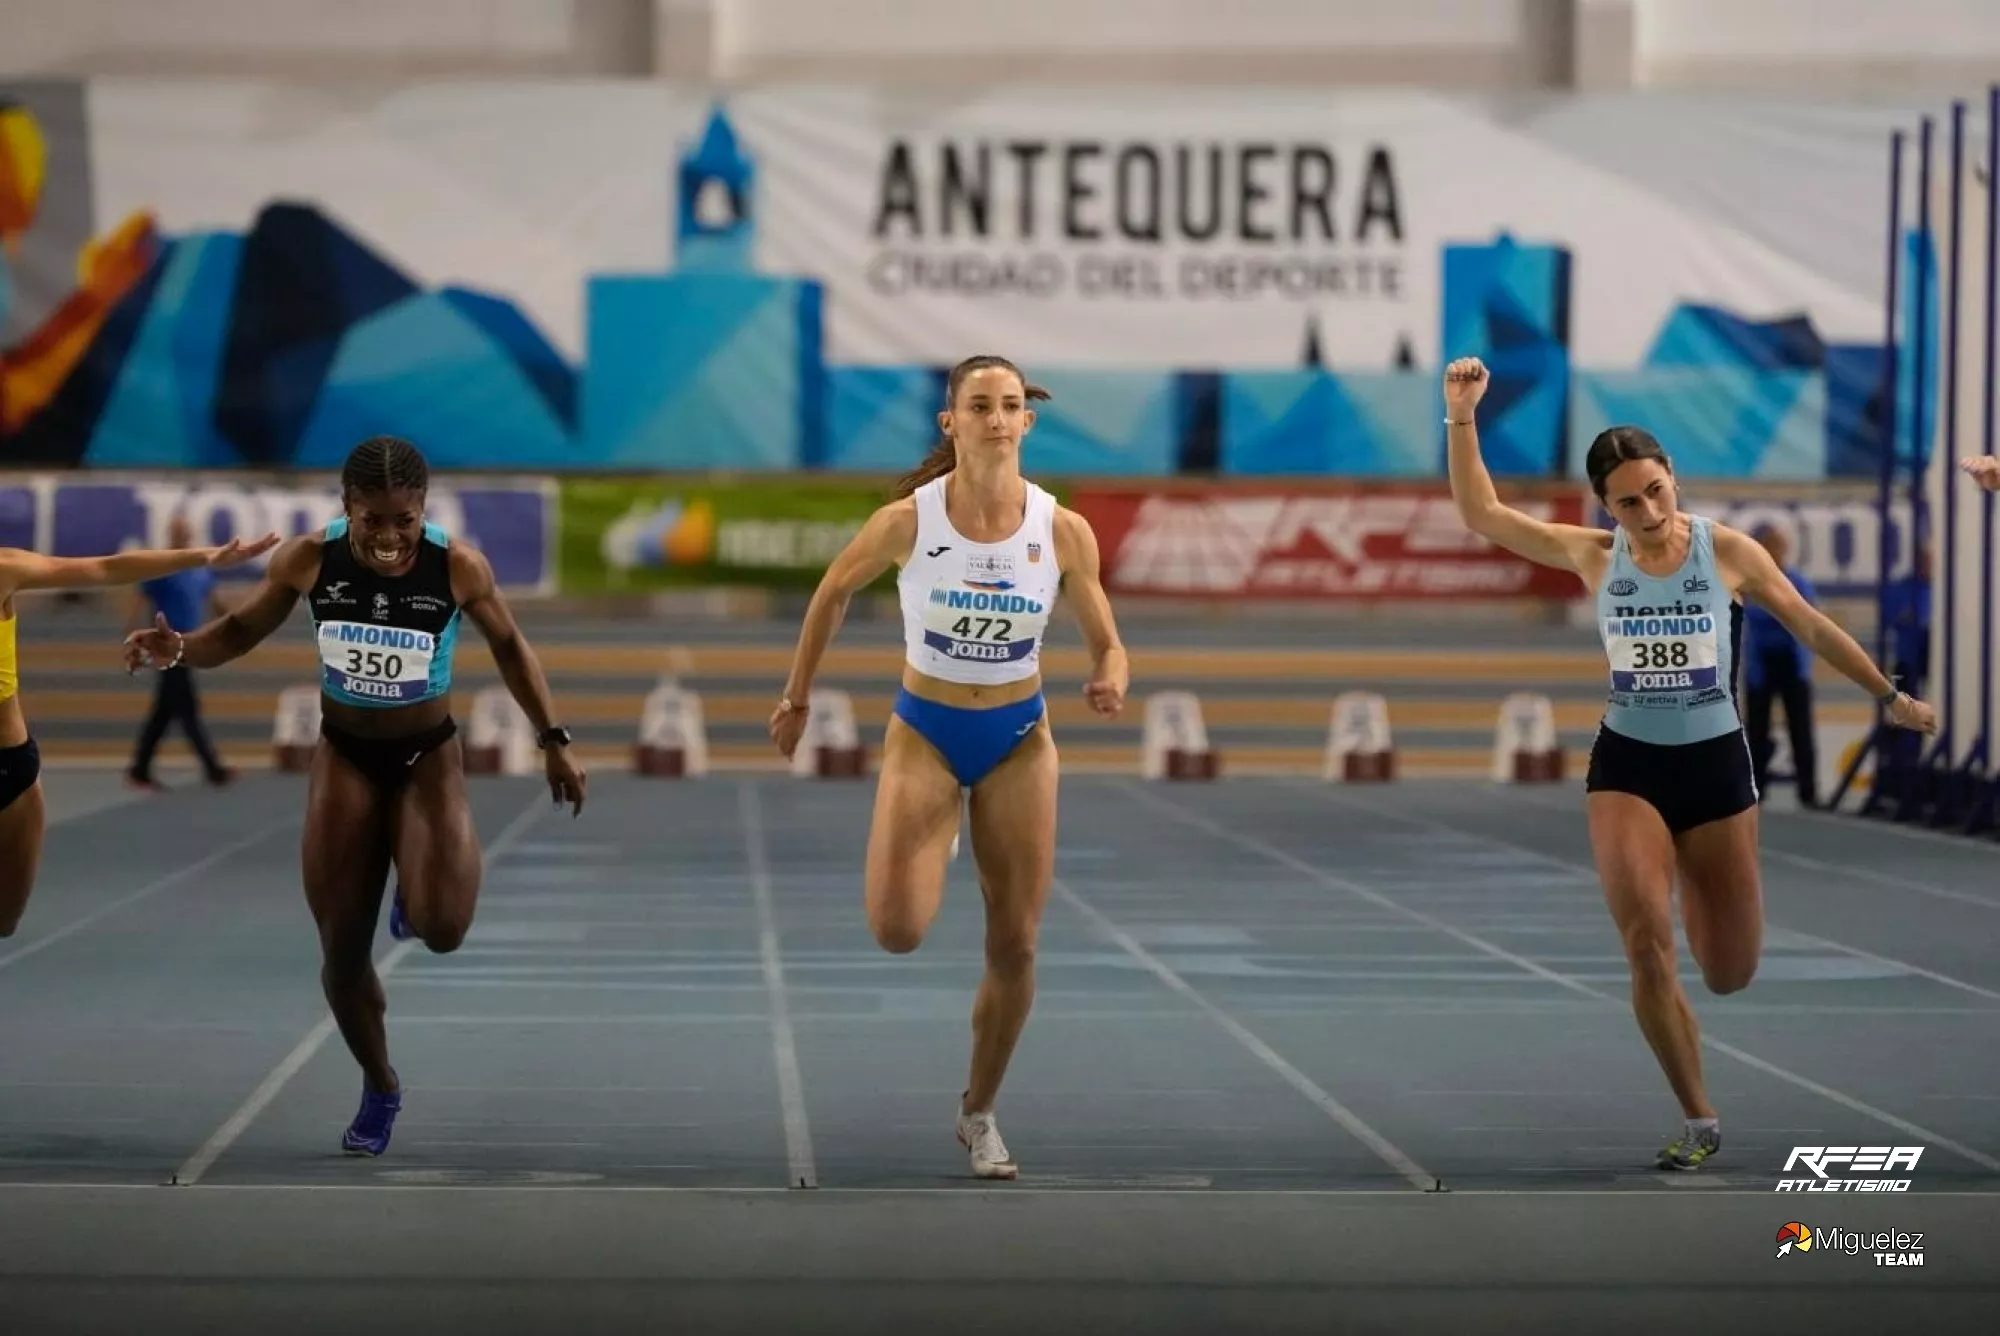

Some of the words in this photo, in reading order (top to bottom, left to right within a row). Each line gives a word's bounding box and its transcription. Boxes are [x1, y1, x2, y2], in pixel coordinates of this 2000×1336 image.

[873, 141, 1404, 241] ANTEQUERA
[867, 250, 1064, 297] CIUDAD
[1074, 252, 1163, 298] DEL
[1178, 253, 1405, 300] DEPORTE
[948, 590, 1043, 613] MONDO
[340, 625, 430, 650] MONDO
[952, 617, 1012, 641] 472
[1622, 617, 1712, 636] MONDO
[346, 650, 402, 679] 350
[1632, 643, 1688, 668] 388
